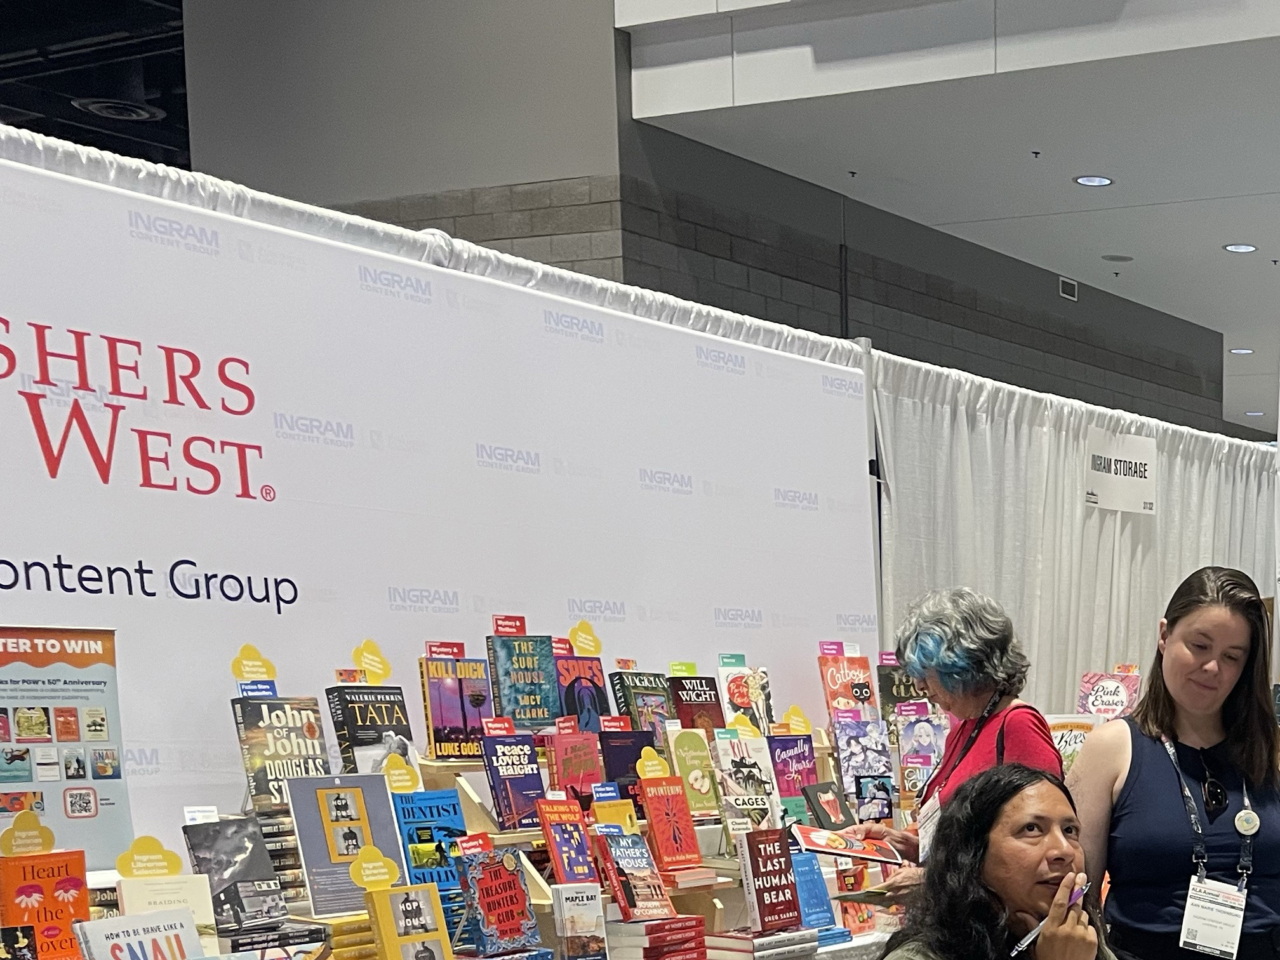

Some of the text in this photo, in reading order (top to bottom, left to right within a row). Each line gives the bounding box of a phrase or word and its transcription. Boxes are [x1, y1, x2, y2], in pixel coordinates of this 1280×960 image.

[128, 210, 220, 249] INGRAM
[358, 264, 432, 297] INGRAM
[544, 310, 604, 338] INGRAM
[274, 412, 354, 439] INGRAM
[476, 442, 541, 467] INGRAM
[1091, 454, 1148, 479] INGRAM STORAGE
[639, 468, 693, 489] INGRAM
[169, 559, 298, 614] Group
[388, 586, 459, 606] INGRAM
[568, 598, 625, 615] INGRAM
[34, 639, 60, 653] TO
[62, 640, 102, 654] WIN
[512, 641, 534, 653] THE
[428, 661, 487, 679] KILL DICK
[513, 656, 538, 670] SURF
[510, 670, 545, 685] HOUSE
[557, 659, 604, 687] SPIES
[827, 668, 870, 690] Catboy
[682, 680, 709, 690] WILL
[1090, 685, 1120, 696] Pink
[678, 691, 716, 702] WIGHT
[1092, 695, 1124, 707] Eraser
[258, 703, 314, 728] John
[348, 703, 407, 726] TATA
[515, 707, 549, 719] CLARKE
[274, 728, 289, 738] OF
[263, 732, 321, 757] John
[436, 742, 458, 756] LUKE
[495, 744, 531, 757] Peace
[775, 739, 809, 762] Casually
[264, 758, 325, 780] DOUGLAS
[399, 795, 415, 806] THE
[734, 798, 766, 806] CAGES
[402, 802, 460, 820] DENTIST
[541, 804, 579, 813] TALKING TO
[545, 813, 581, 821] THE WOLF
[619, 837, 633, 847] MY
[611, 846, 649, 858] FATHER'S
[758, 843, 781, 857] THE
[618, 855, 649, 868] HOUSE
[758, 857, 787, 871] LAST
[21, 863, 71, 882] Heart
[489, 869, 502, 882] THE
[754, 869, 795, 889] HUMAN
[481, 879, 517, 899] TREASURE
[486, 893, 519, 913] HUNTERS
[764, 889, 793, 905] BEAR
[399, 901, 425, 912] HOPE
[36, 906, 64, 923] the
[399, 917, 431, 927] HOUSE
[497, 910, 515, 924] CLUB
[764, 910, 798, 922] GREG SARRIS
[104, 931, 120, 941] HOW
[122, 930, 131, 939] TO
[133, 928, 141, 936] BE
[142, 926, 162, 935] BRAVE
[163, 924, 178, 933] LIKE
